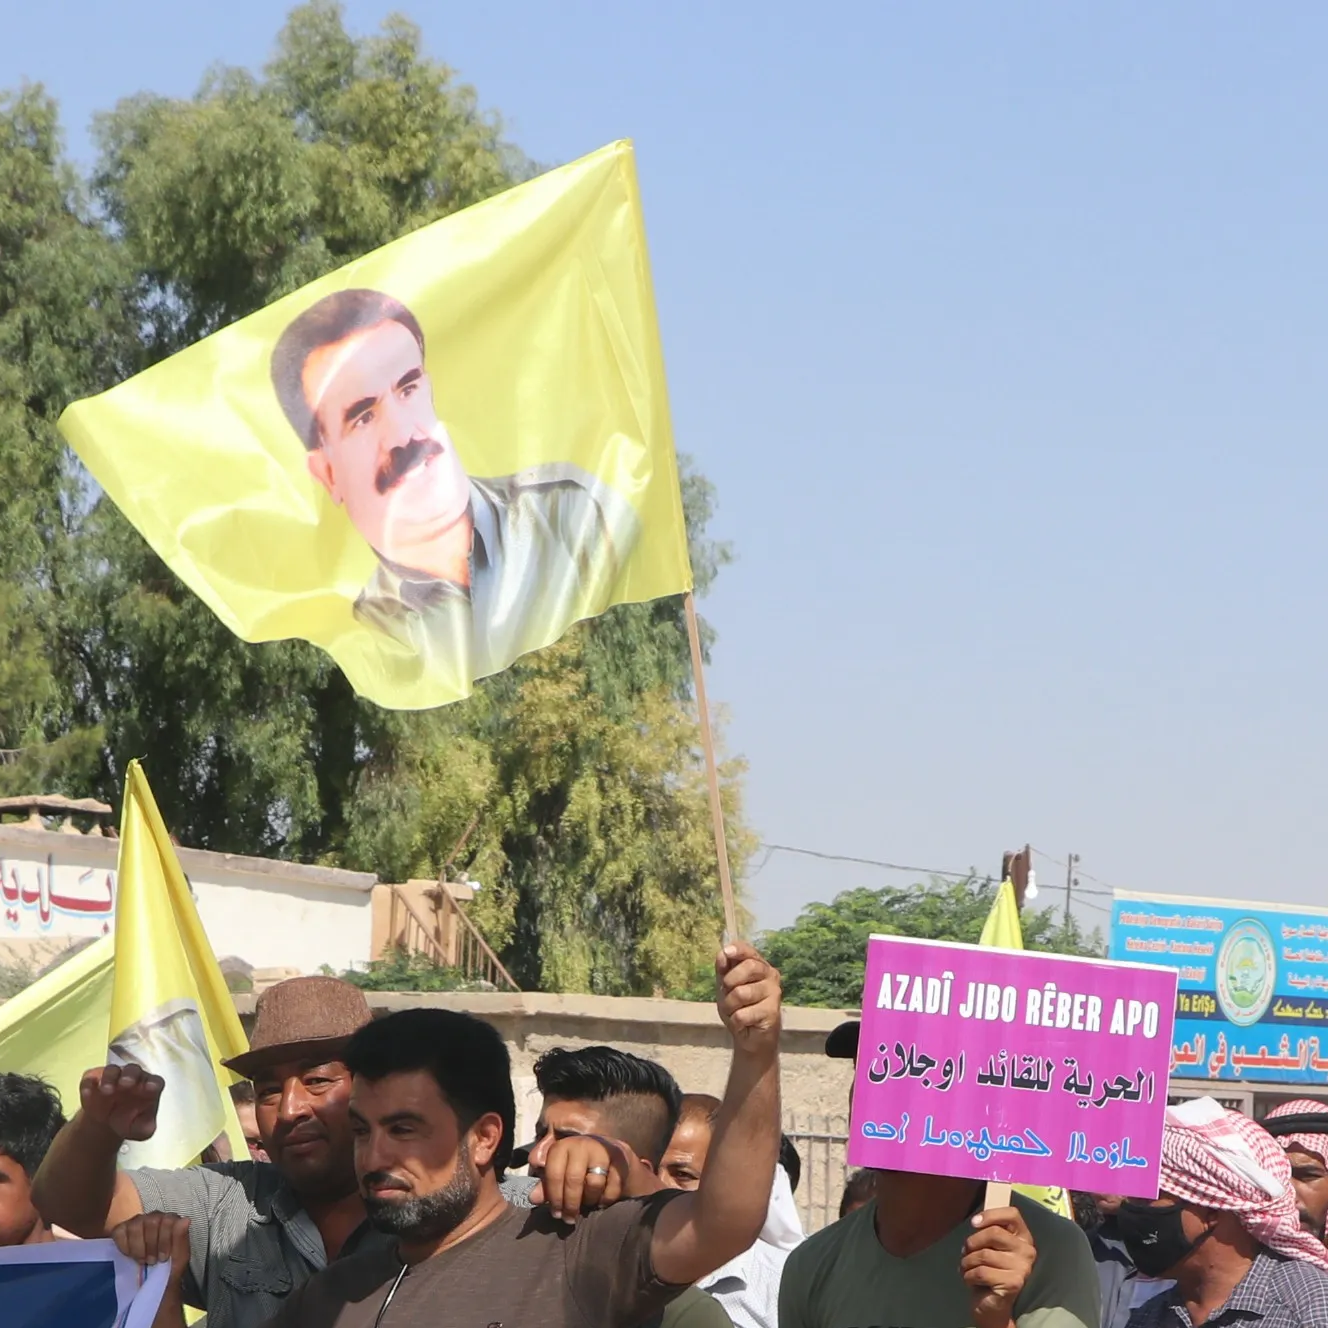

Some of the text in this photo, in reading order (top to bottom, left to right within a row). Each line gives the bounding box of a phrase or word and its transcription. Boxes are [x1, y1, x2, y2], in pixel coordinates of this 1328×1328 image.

[876, 970, 1160, 1039] AZADÎ JIBO RÊBER APO
[868, 1040, 1156, 1108] الحرية للقائد اوجلان
[1208, 1031, 1227, 1078] في
[1231, 1033, 1309, 1076] الشعب
